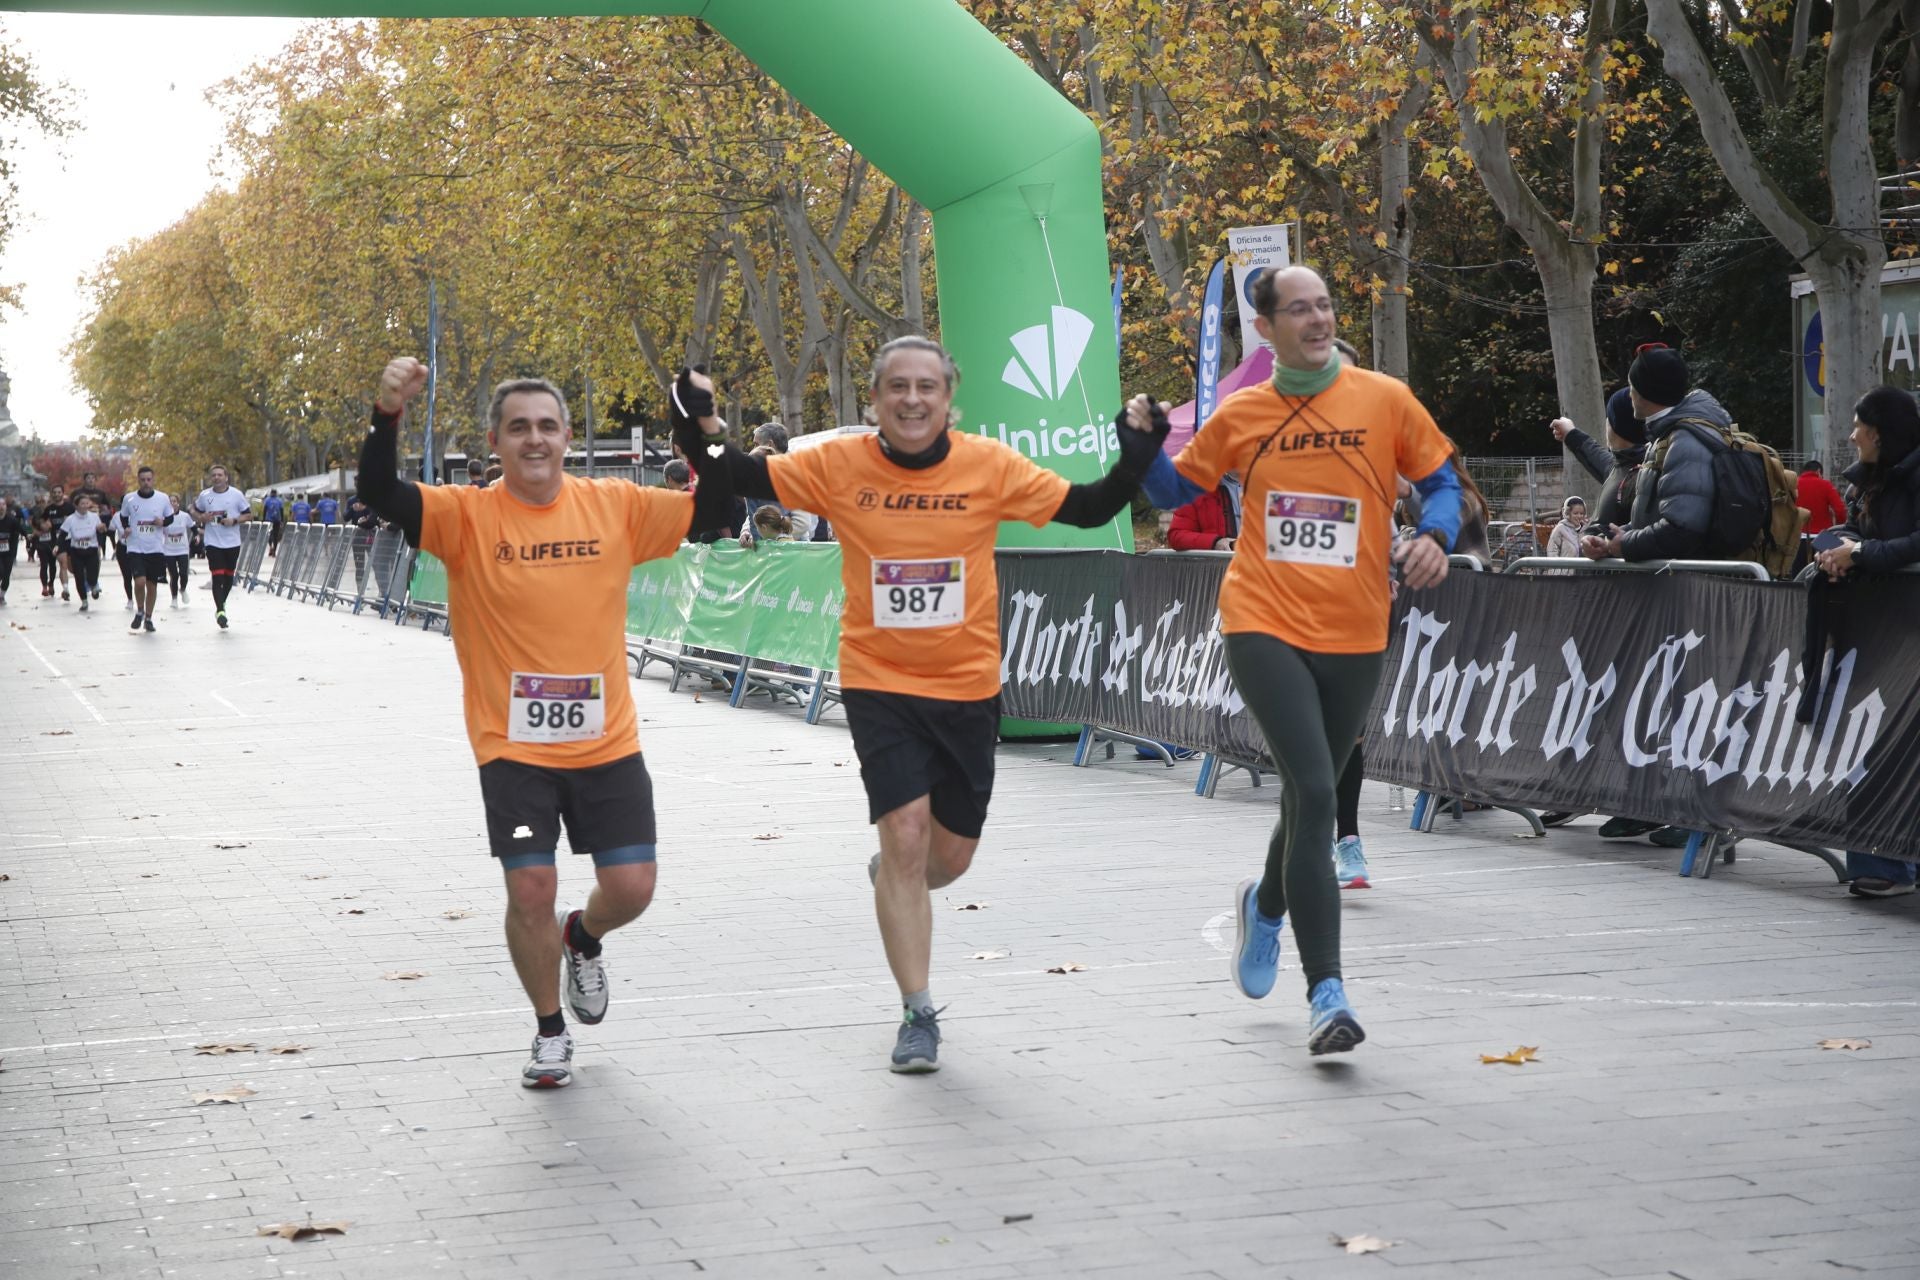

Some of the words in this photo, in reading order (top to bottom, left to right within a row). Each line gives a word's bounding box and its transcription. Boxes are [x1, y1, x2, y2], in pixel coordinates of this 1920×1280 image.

[1237, 236, 1262, 244] Oficina
[1263, 235, 1272, 243] de
[1280, 428, 1367, 452] LIFETEC
[884, 494, 970, 510] LIFETEC
[1280, 519, 1336, 550] 985
[520, 540, 600, 561] LIFETEC
[889, 586, 945, 613] 987
[1001, 588, 1102, 687] Norte
[1382, 606, 1536, 755] Norte
[1540, 636, 1617, 762] de
[527, 700, 585, 729] 986
